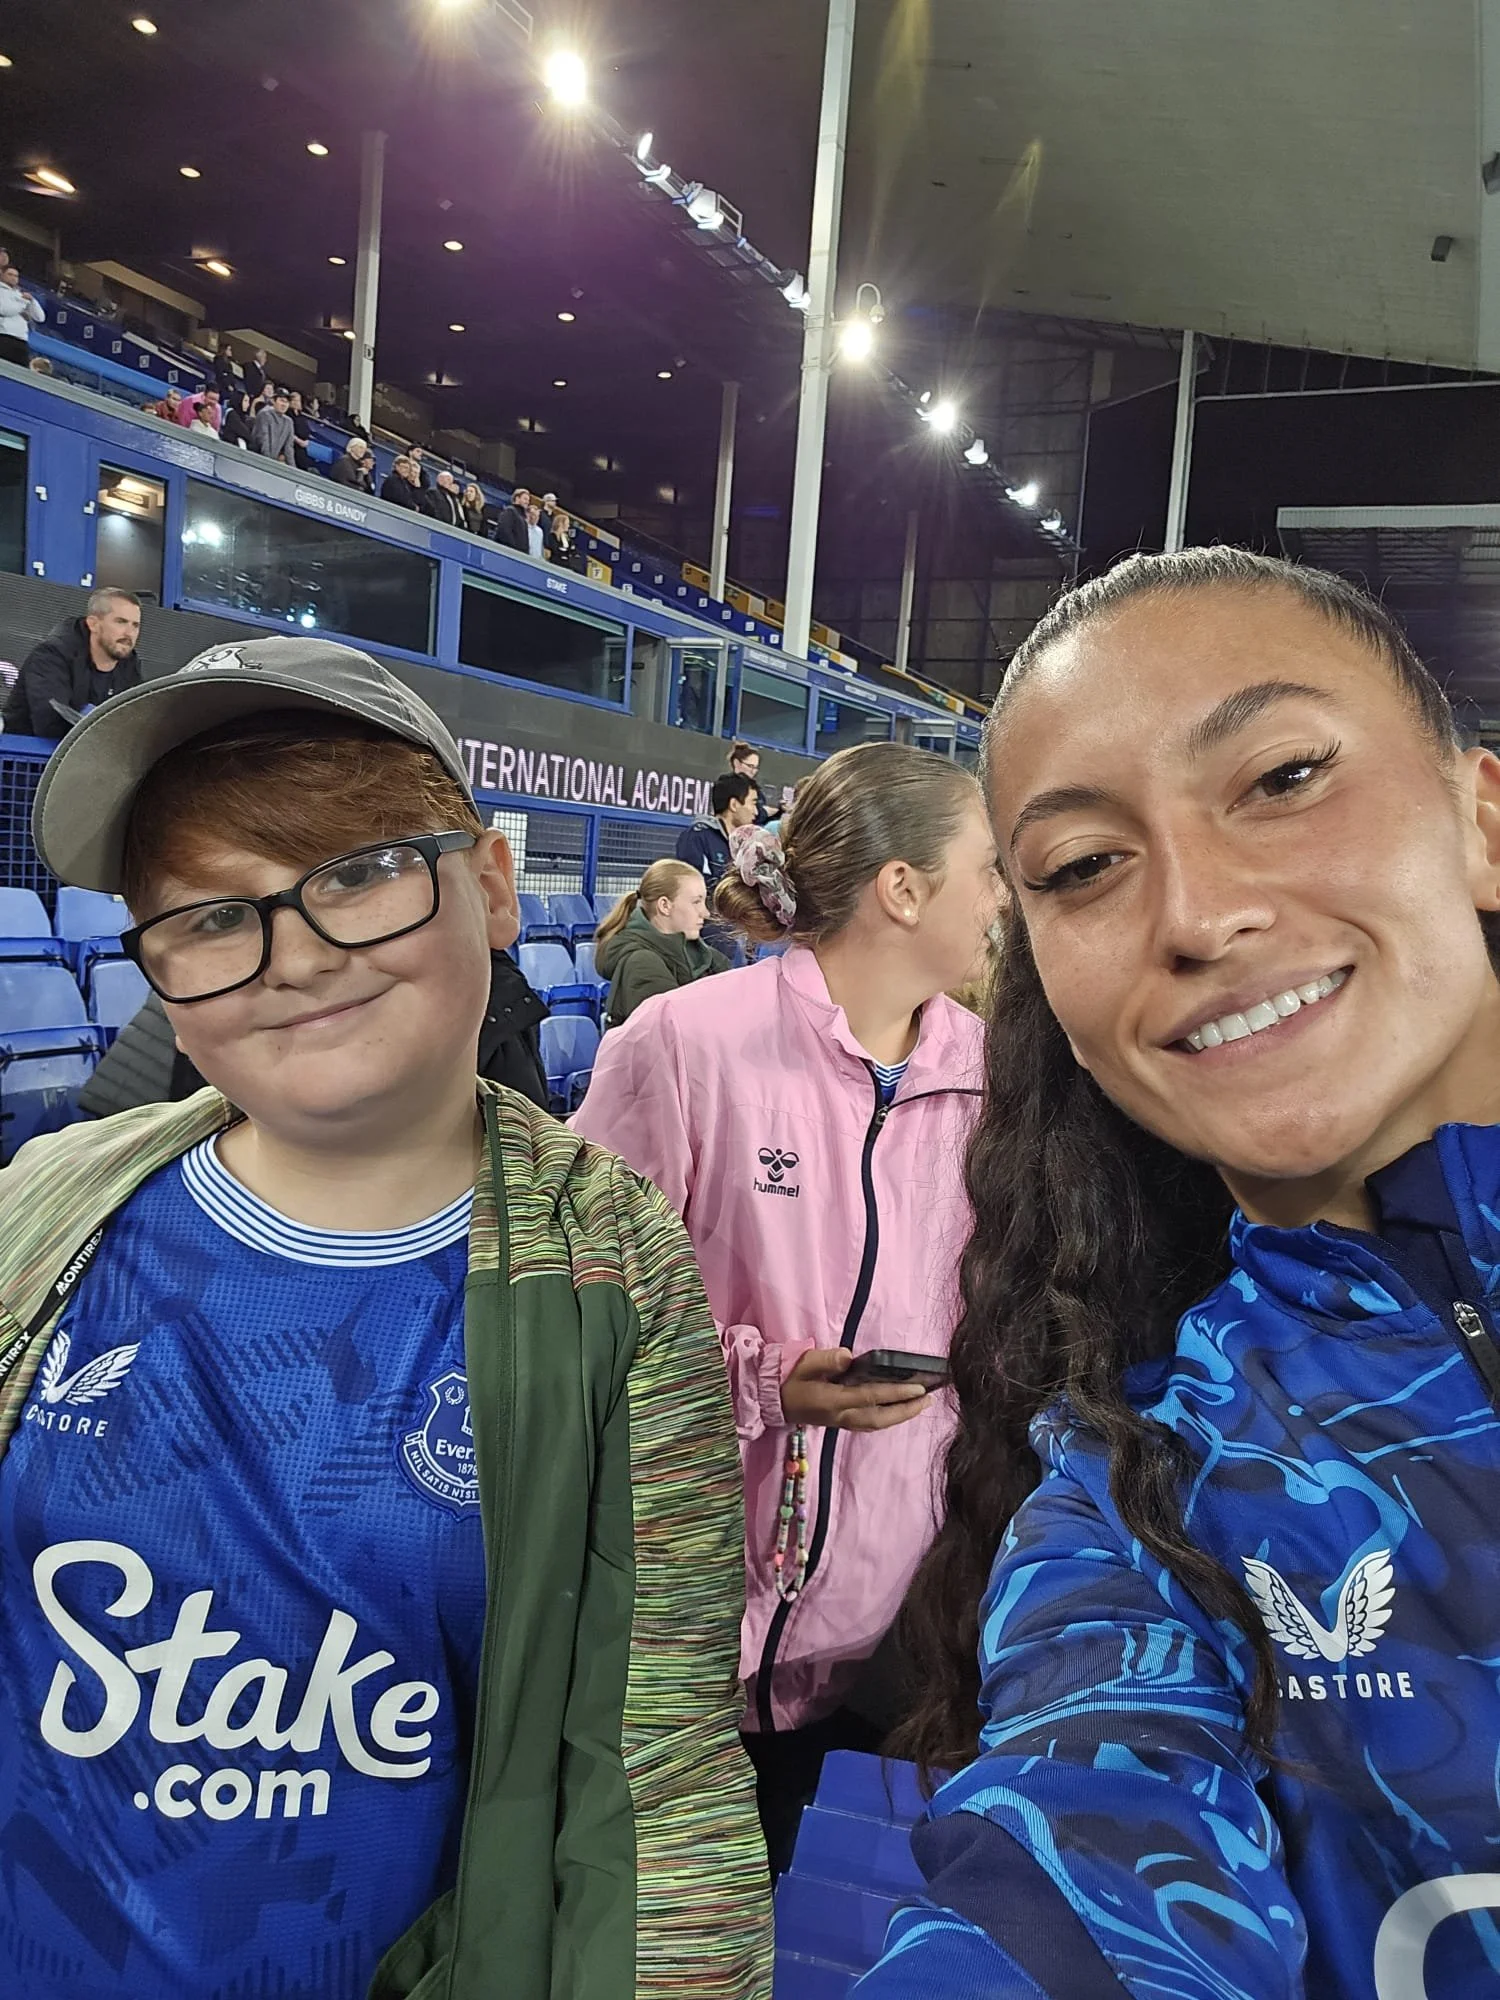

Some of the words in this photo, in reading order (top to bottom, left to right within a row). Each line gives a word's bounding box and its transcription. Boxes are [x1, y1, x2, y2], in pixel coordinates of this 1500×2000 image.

[295, 489, 325, 509] GIBBS
[326, 500, 334, 512] &
[334, 503, 367, 522] DANDY
[753, 1177, 800, 1198] hummel
[55, 1228, 104, 1296] MONTIREX
[435, 1438, 477, 1460] Ever
[410, 1450, 424, 1472] NIL
[422, 1469, 450, 1493] SATIS
[451, 1487, 476, 1499] NISI
[33, 1539, 440, 1779] Stake
[1276, 1671, 1415, 1701] ASTORE
[133, 1763, 331, 1821] .com
